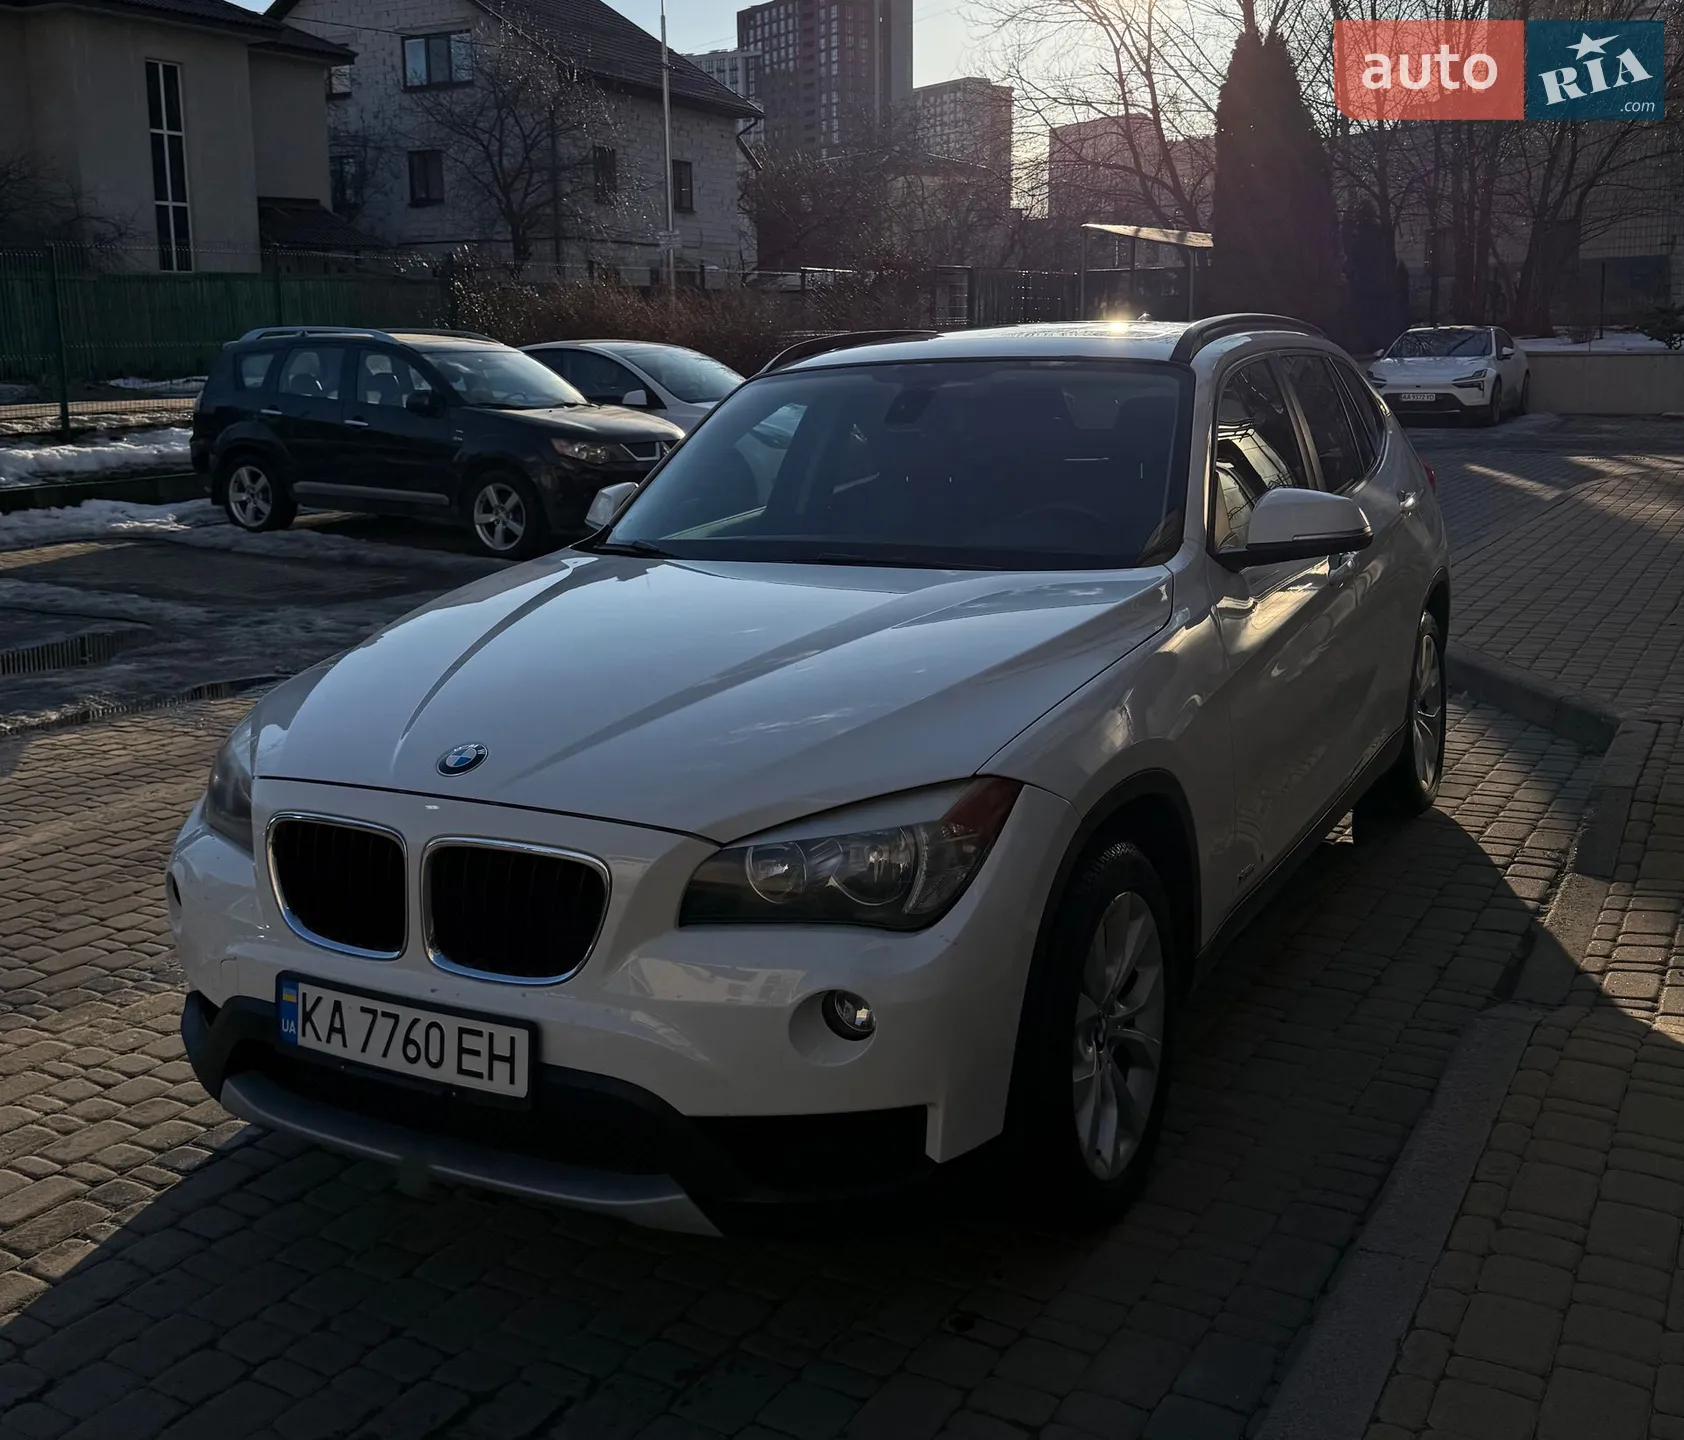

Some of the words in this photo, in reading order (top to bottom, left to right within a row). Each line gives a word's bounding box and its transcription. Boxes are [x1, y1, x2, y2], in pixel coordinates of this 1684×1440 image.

[281, 1018, 297, 1035] UA
[301, 992, 348, 1049] KA
[360, 1006, 445, 1069] 7760
[457, 1026, 516, 1085] EH
